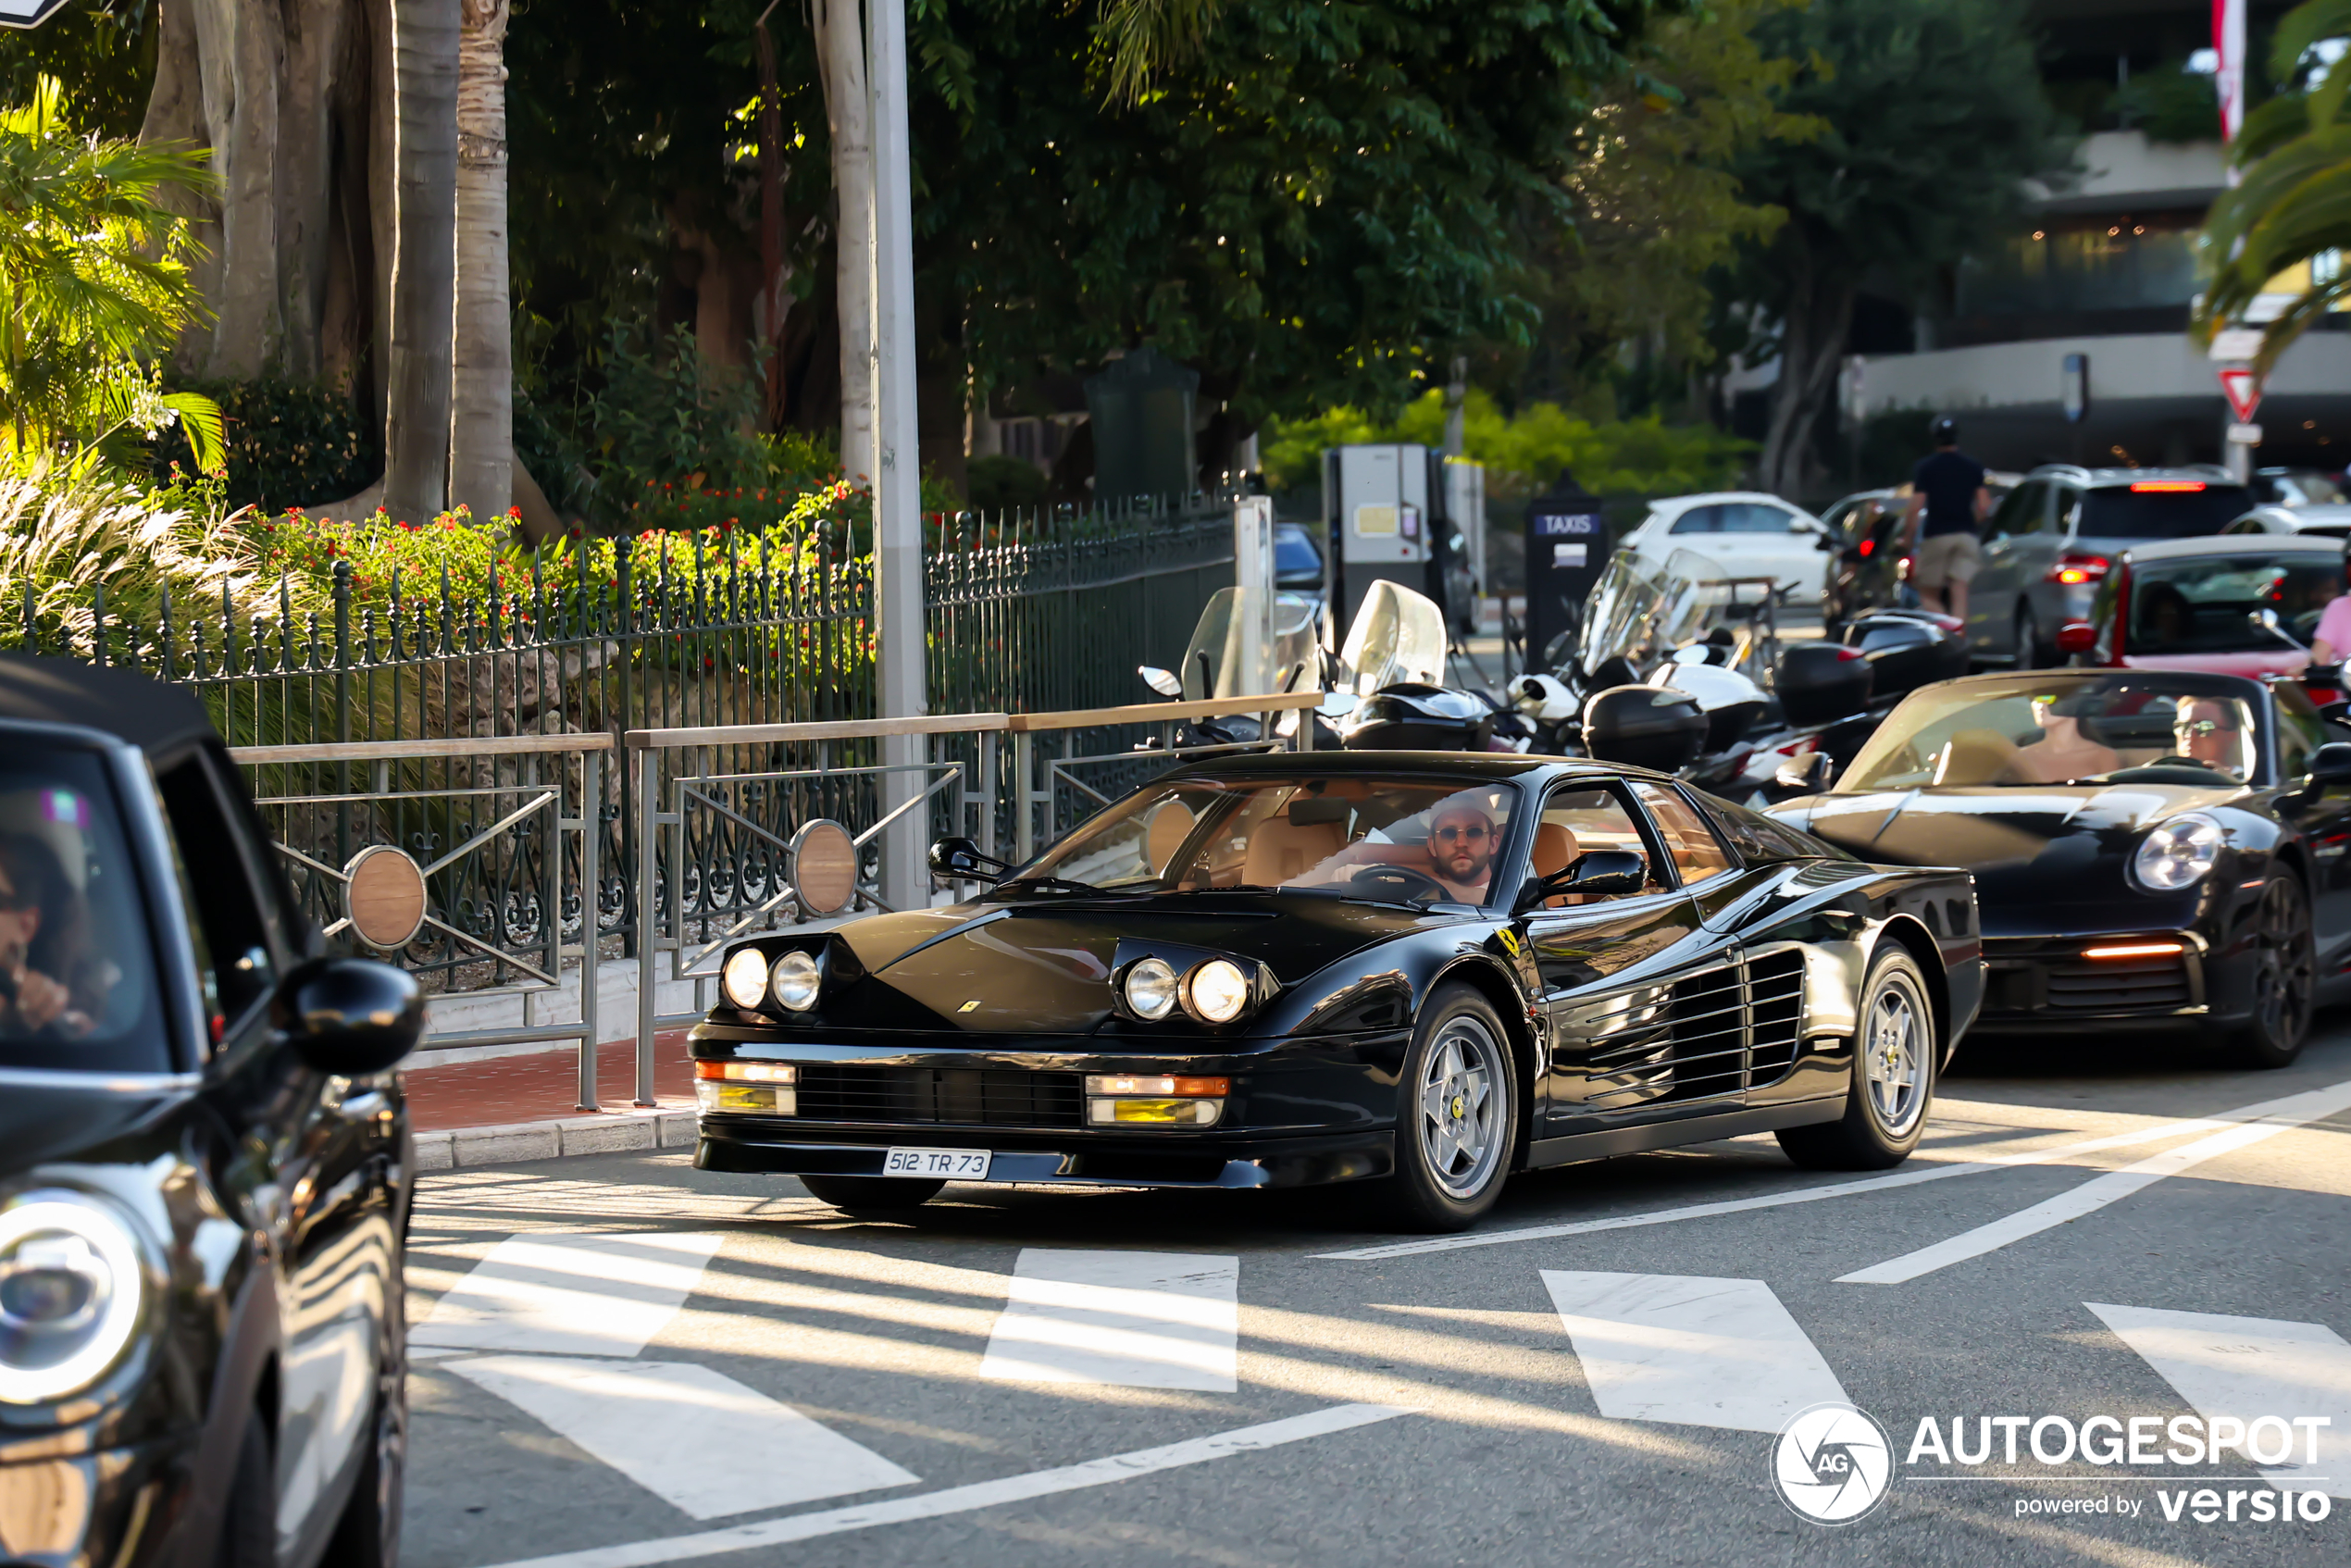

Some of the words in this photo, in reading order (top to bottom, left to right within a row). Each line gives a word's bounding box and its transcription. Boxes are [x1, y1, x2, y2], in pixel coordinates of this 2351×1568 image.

[1544, 515, 1592, 534] TAXIS
[889, 1153, 920, 1170] 512
[928, 1154, 952, 1172] TR
[957, 1155, 985, 1173] 73
